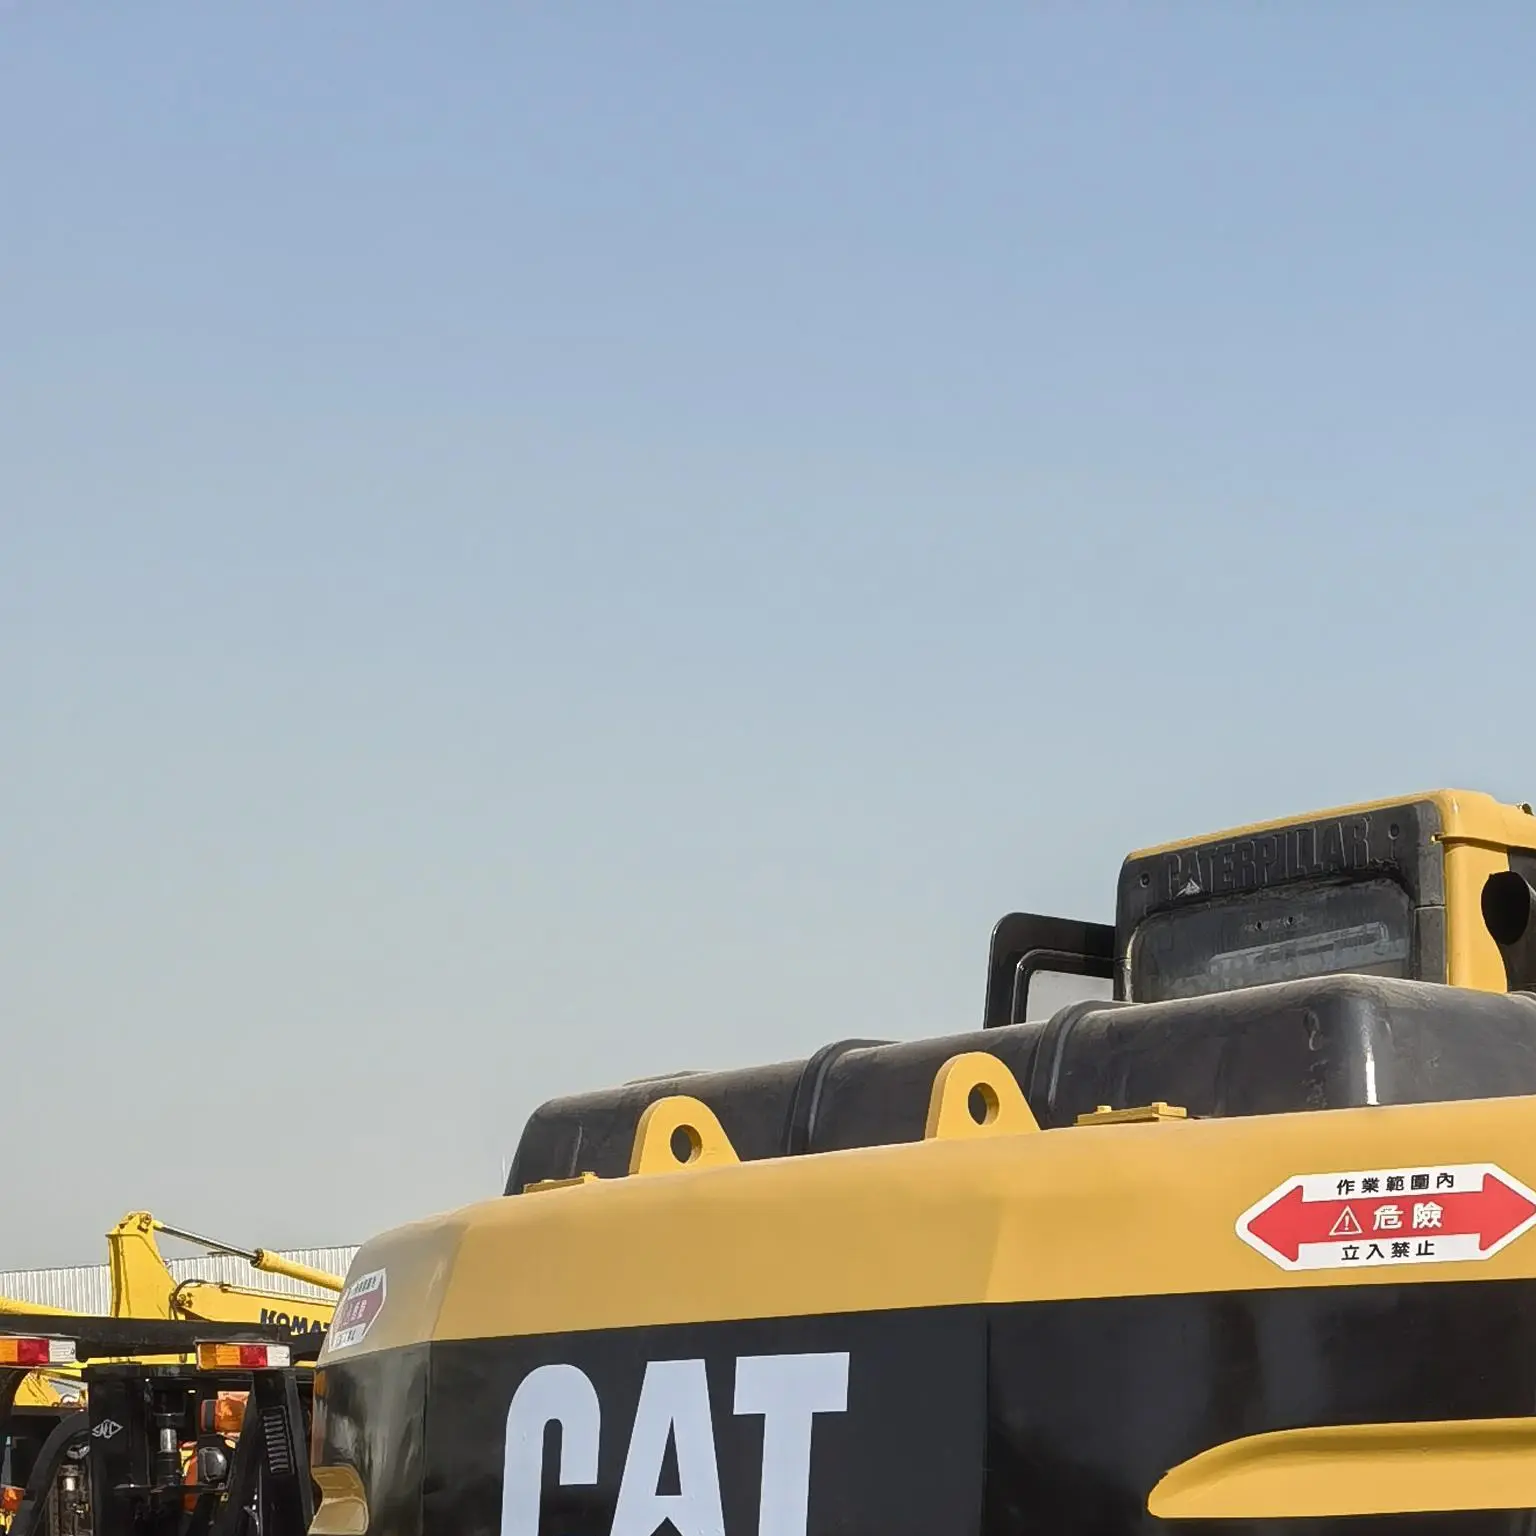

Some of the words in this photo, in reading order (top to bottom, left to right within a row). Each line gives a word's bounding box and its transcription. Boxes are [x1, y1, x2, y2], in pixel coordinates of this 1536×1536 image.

[1164, 816, 1370, 900] CATERPILLAR
[1373, 1201, 1444, 1230] 危險
[1341, 1240, 1435, 1260] 立入禁止
